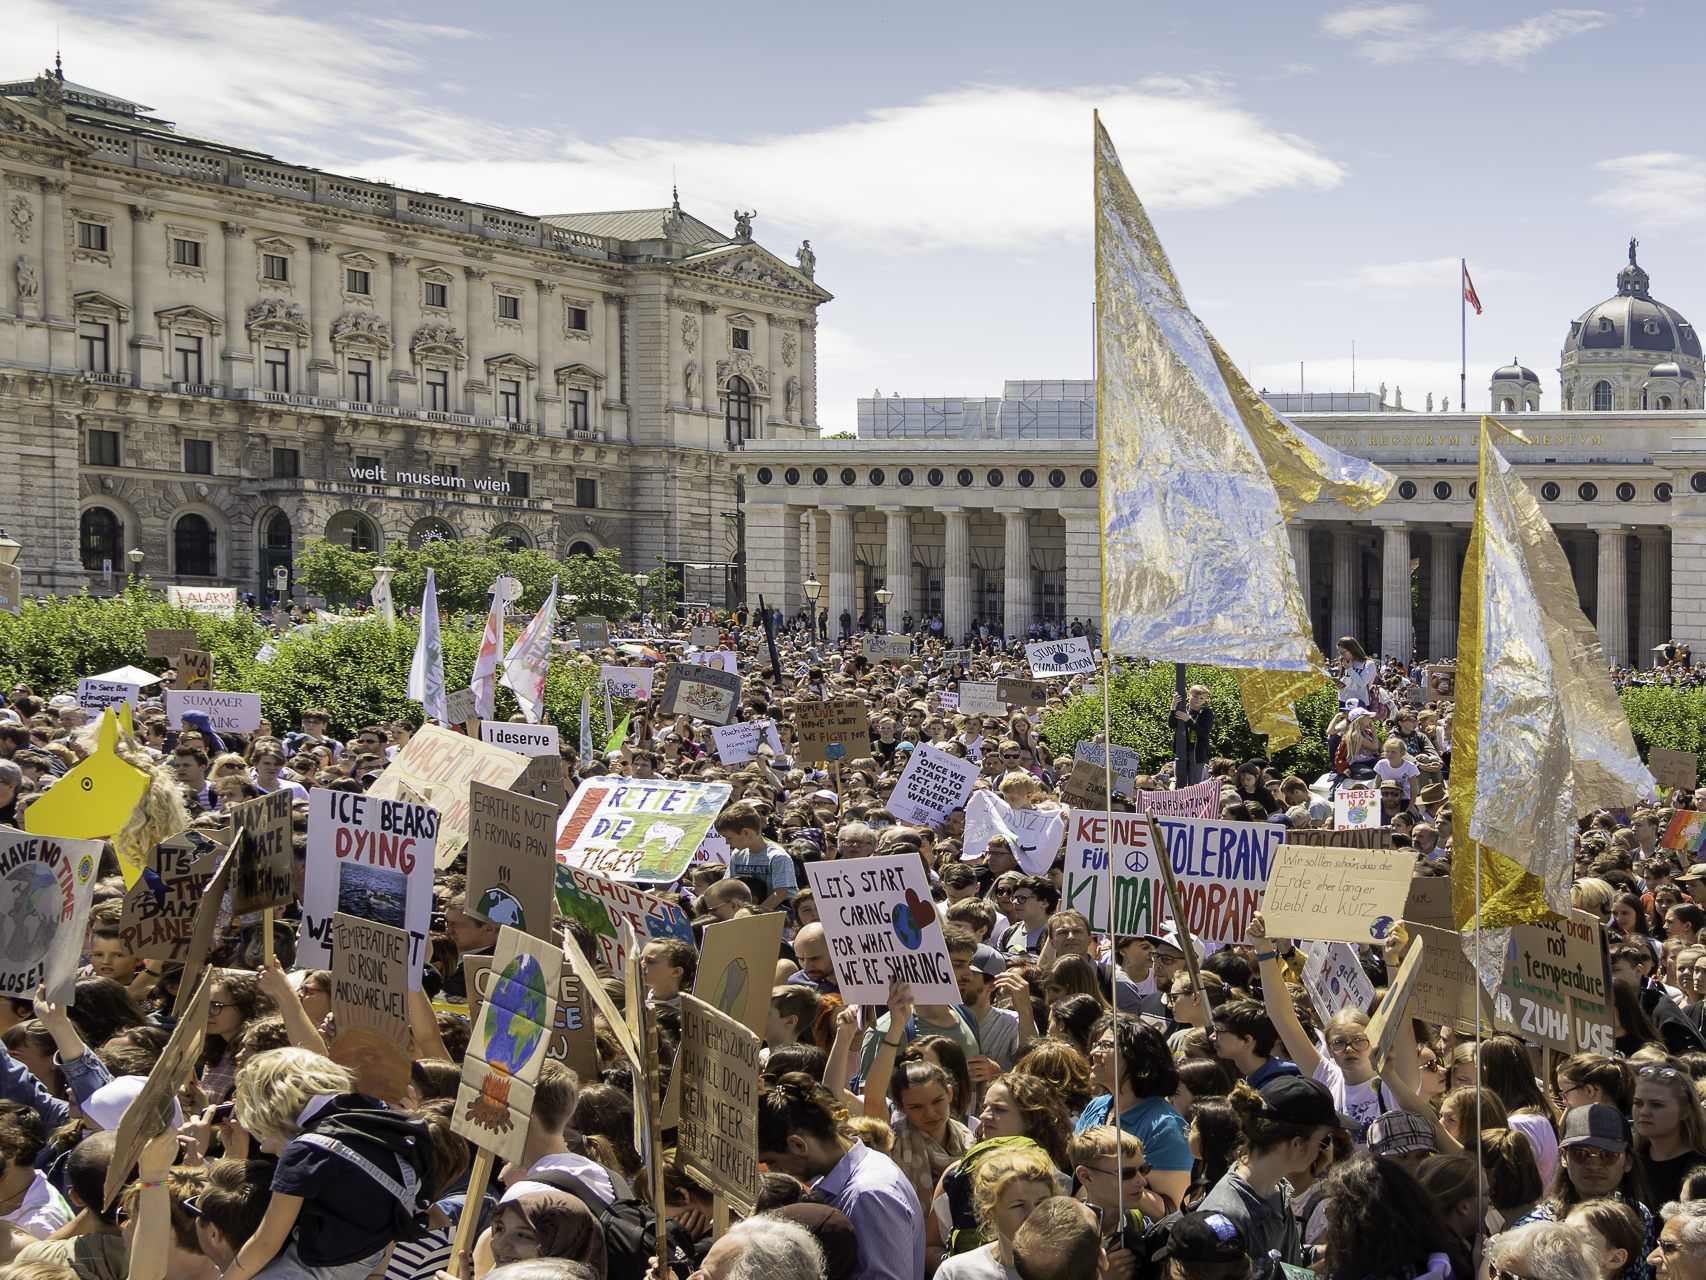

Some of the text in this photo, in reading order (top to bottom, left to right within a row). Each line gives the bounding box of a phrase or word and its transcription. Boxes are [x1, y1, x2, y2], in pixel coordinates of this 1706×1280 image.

[350, 465, 511, 492] welt museum wien
[1033, 643, 1075, 660] STUDENTS
[1033, 657, 1092, 672] CLIMATE ACTION
[116, 684, 128, 692] the
[675, 664, 736, 686] No Planet B
[183, 695, 243, 708] SUMMER
[796, 704, 820, 713] HOME
[813, 708, 834, 718] LIVE
[489, 728, 550, 746] I deserve
[801, 719, 824, 728] HOME
[803, 731, 865, 742] WE FIGHT FOR
[915, 766, 962, 790] START TO
[920, 759, 966, 783] ONCE WE
[608, 786, 704, 813] RETTET
[908, 774, 961, 800] ACT, HOPE
[908, 782, 953, 806] IS EVERY-
[1337, 791, 1375, 799] THERES
[266, 791, 289, 822] THE
[330, 792, 367, 826] ICE
[380, 800, 438, 840] BEARS
[474, 791, 509, 820] EARTH
[511, 803, 520, 823] IS
[525, 810, 551, 833] NOT
[907, 792, 945, 813] WHERE.
[473, 819, 547, 858] A FRYING PAN
[591, 818, 632, 840] DIE
[1076, 816, 1149, 847] KENE
[156, 844, 191, 875] IT'S
[335, 827, 417, 876] DYING
[579, 847, 645, 874] TIGER
[1283, 850, 1303, 866] Wir
[1379, 857, 1392, 871] die
[39, 840, 62, 868] NO
[57, 856, 75, 924] TIME
[273, 872, 290, 901] YOU
[813, 866, 907, 899] LET'S START
[1274, 865, 1375, 900] Erde eher länger
[573, 870, 676, 924] SCHÜTZT
[1270, 888, 1306, 912] bleibt
[1311, 894, 1328, 914] als
[839, 900, 892, 927] CARING
[120, 917, 193, 955] PLANE
[334, 923, 404, 965] TEMPERATURE
[832, 931, 895, 957] FOR WHAT
[1547, 935, 1567, 958] not
[348, 954, 356, 976] IS
[358, 954, 388, 987] RISING
[838, 952, 952, 986] WE'RE SHARING
[1443, 962, 1461, 982] doch
[1524, 950, 1604, 998] temperature
[335, 979, 406, 1022] AND SO ARE WE!
[1436, 985, 1445, 998] in
[683, 1010, 699, 1043] ICH
[697, 1056, 719, 1090] WILL
[722, 1066, 750, 1107] DOCH
[682, 1086, 744, 1142] KEIN MEER
[684, 1121, 697, 1152] IN
